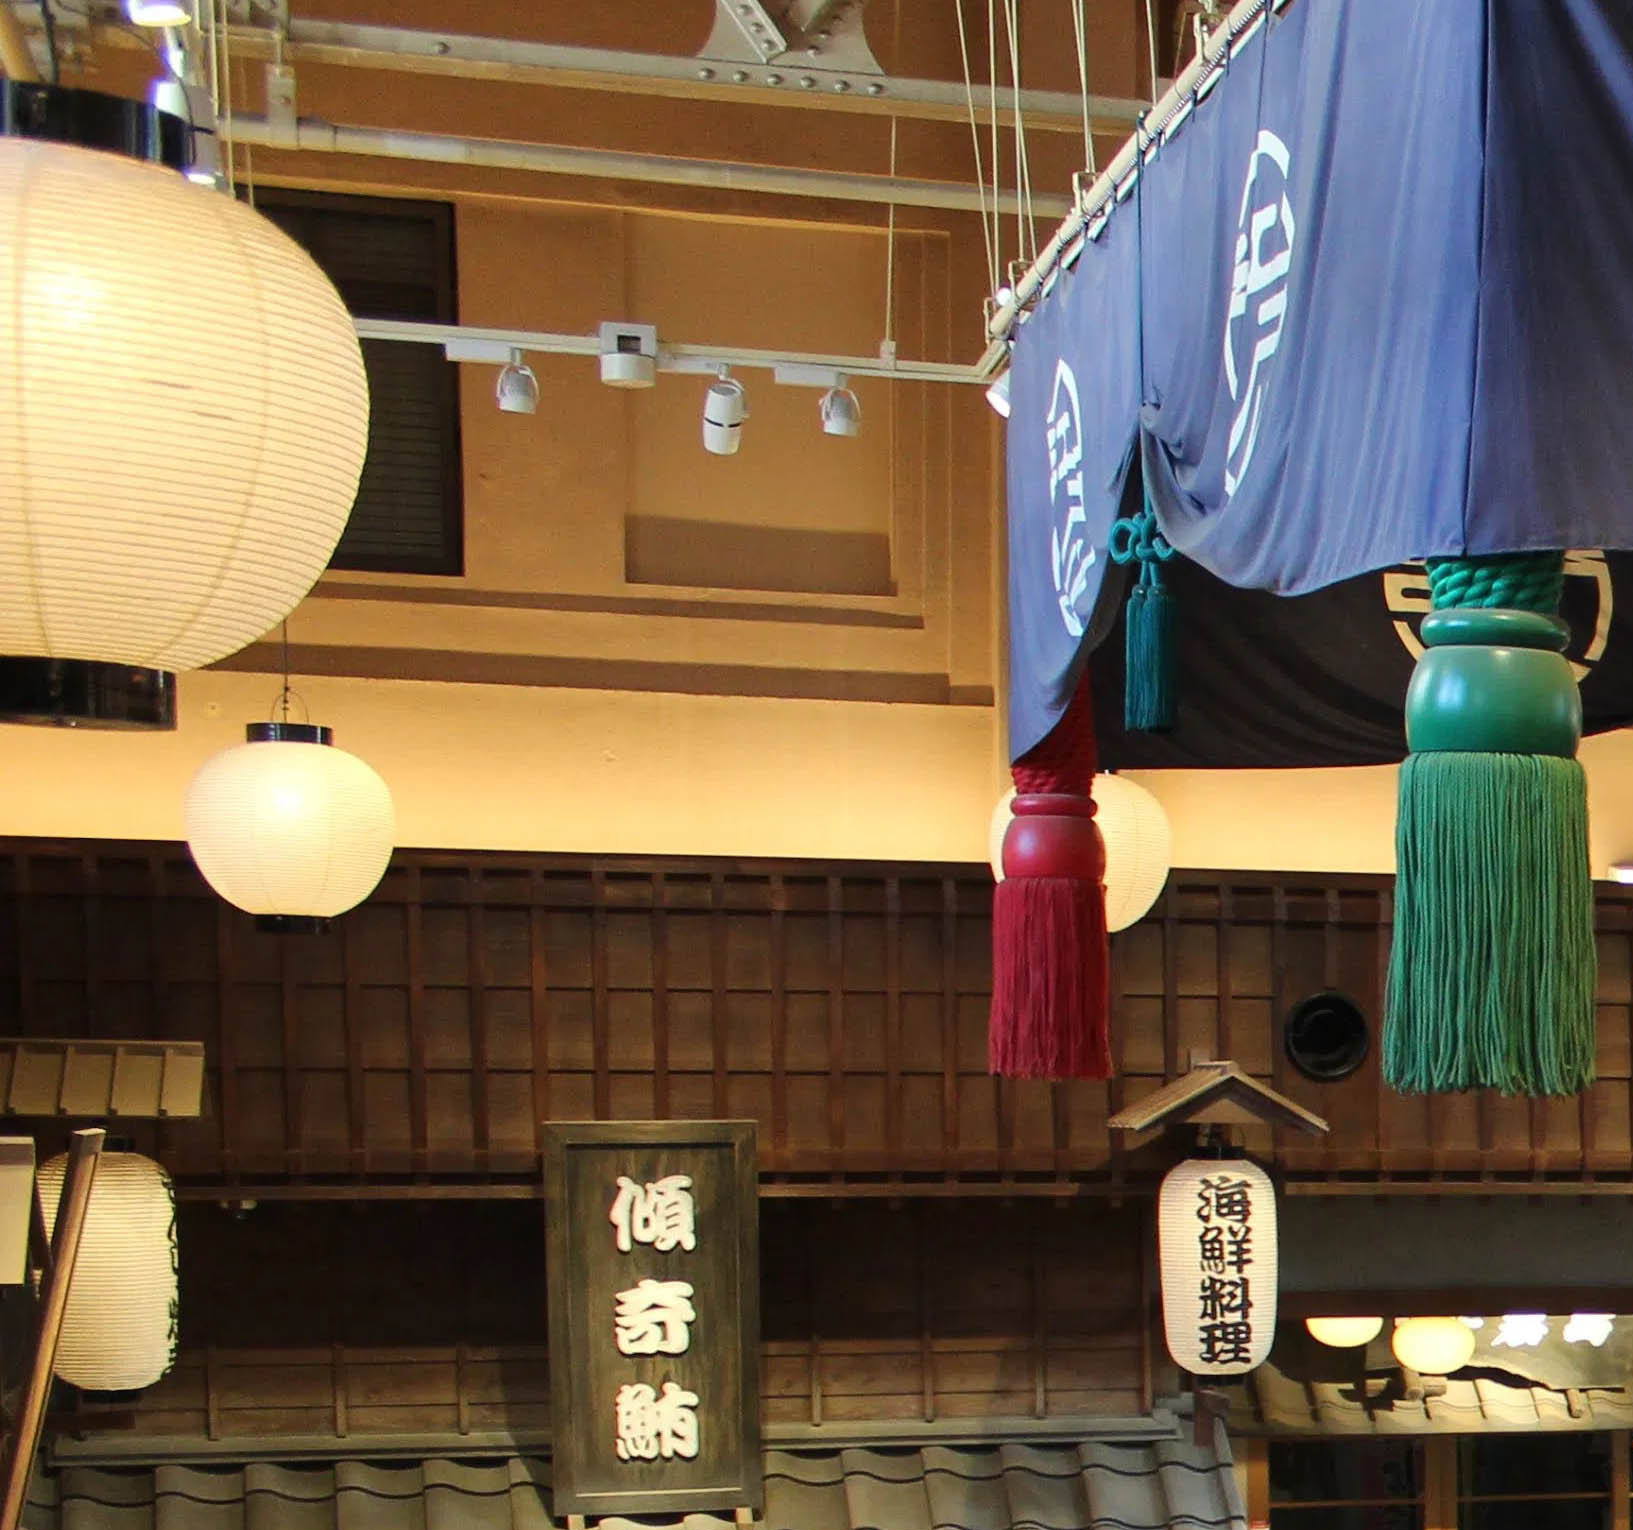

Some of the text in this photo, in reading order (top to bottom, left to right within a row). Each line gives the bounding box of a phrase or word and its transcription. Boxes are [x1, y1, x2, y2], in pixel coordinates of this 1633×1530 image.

[609, 1175, 699, 1460] 傾奇鮪
[1196, 1175, 1254, 1365] 海鮮料理
